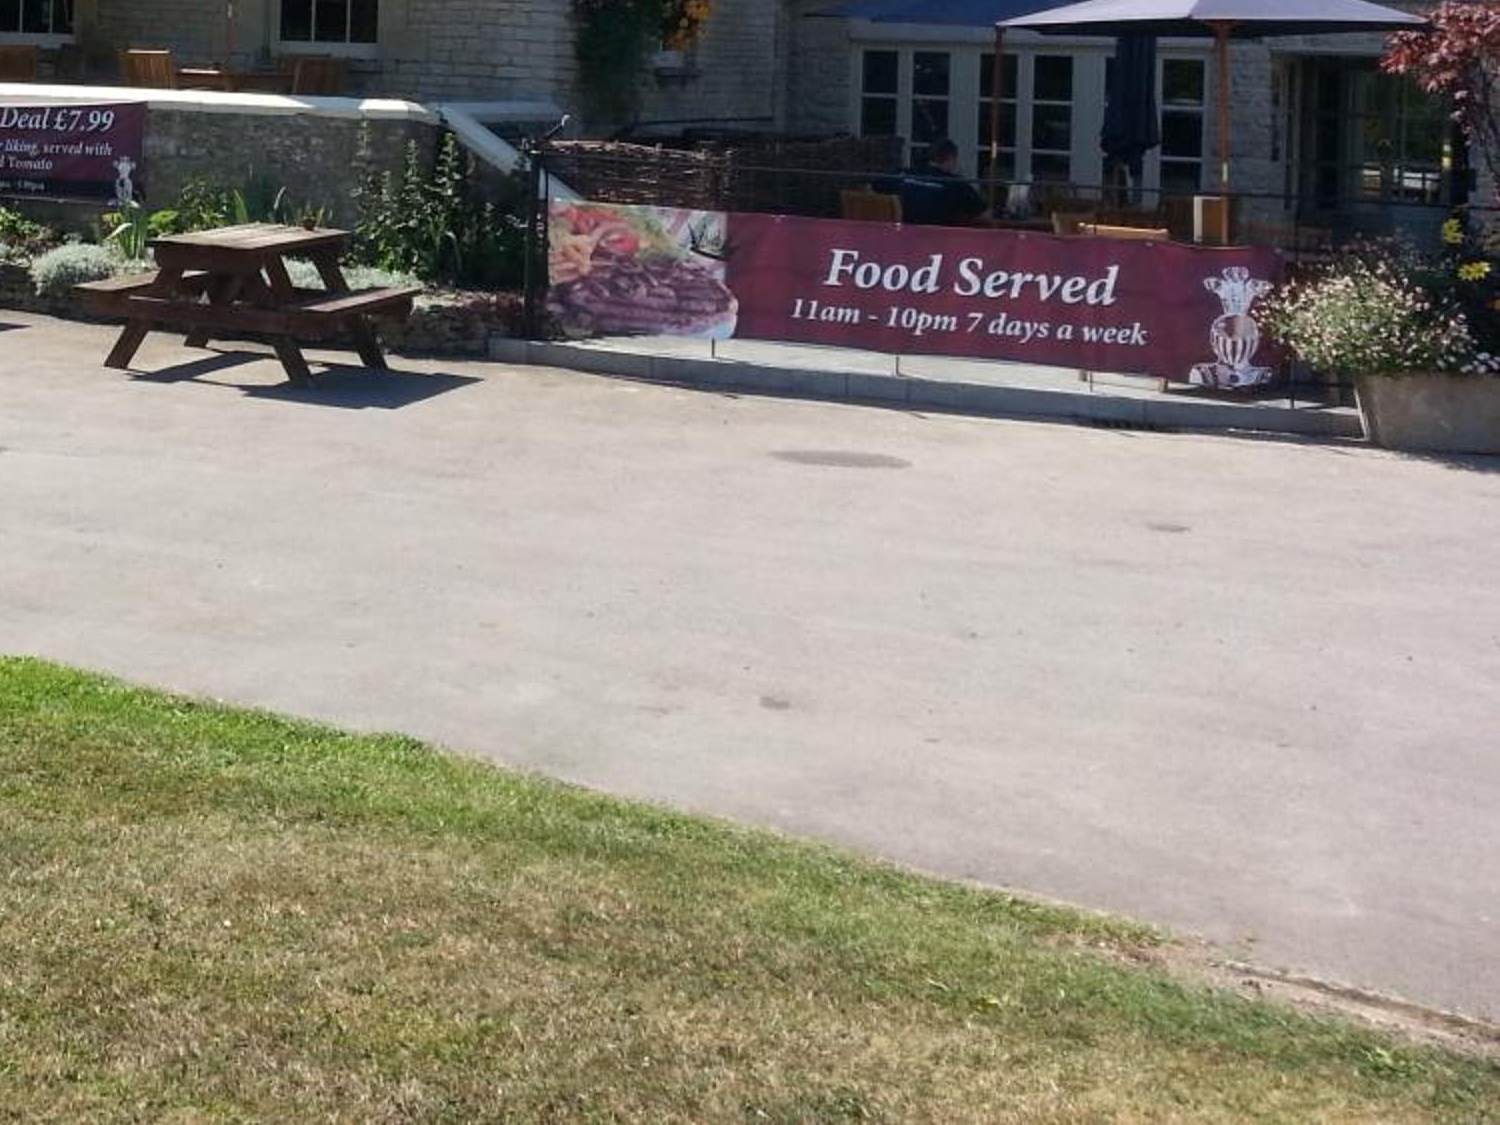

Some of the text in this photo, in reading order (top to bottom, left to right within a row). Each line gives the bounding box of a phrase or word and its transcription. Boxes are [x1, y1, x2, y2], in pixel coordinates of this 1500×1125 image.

[53, 109, 115, 132] £7.99
[43, 141, 83, 154] served
[85, 141, 114, 156] with
[8, 155, 53, 171] Tomato
[823, 248, 1120, 305] Food Served
[791, 298, 860, 323] 11am
[887, 305, 957, 336] 10pm
[966, 312, 983, 332] 7
[988, 313, 1049, 344] days
[1057, 324, 1073, 340] a
[1083, 322, 1148, 346] week
